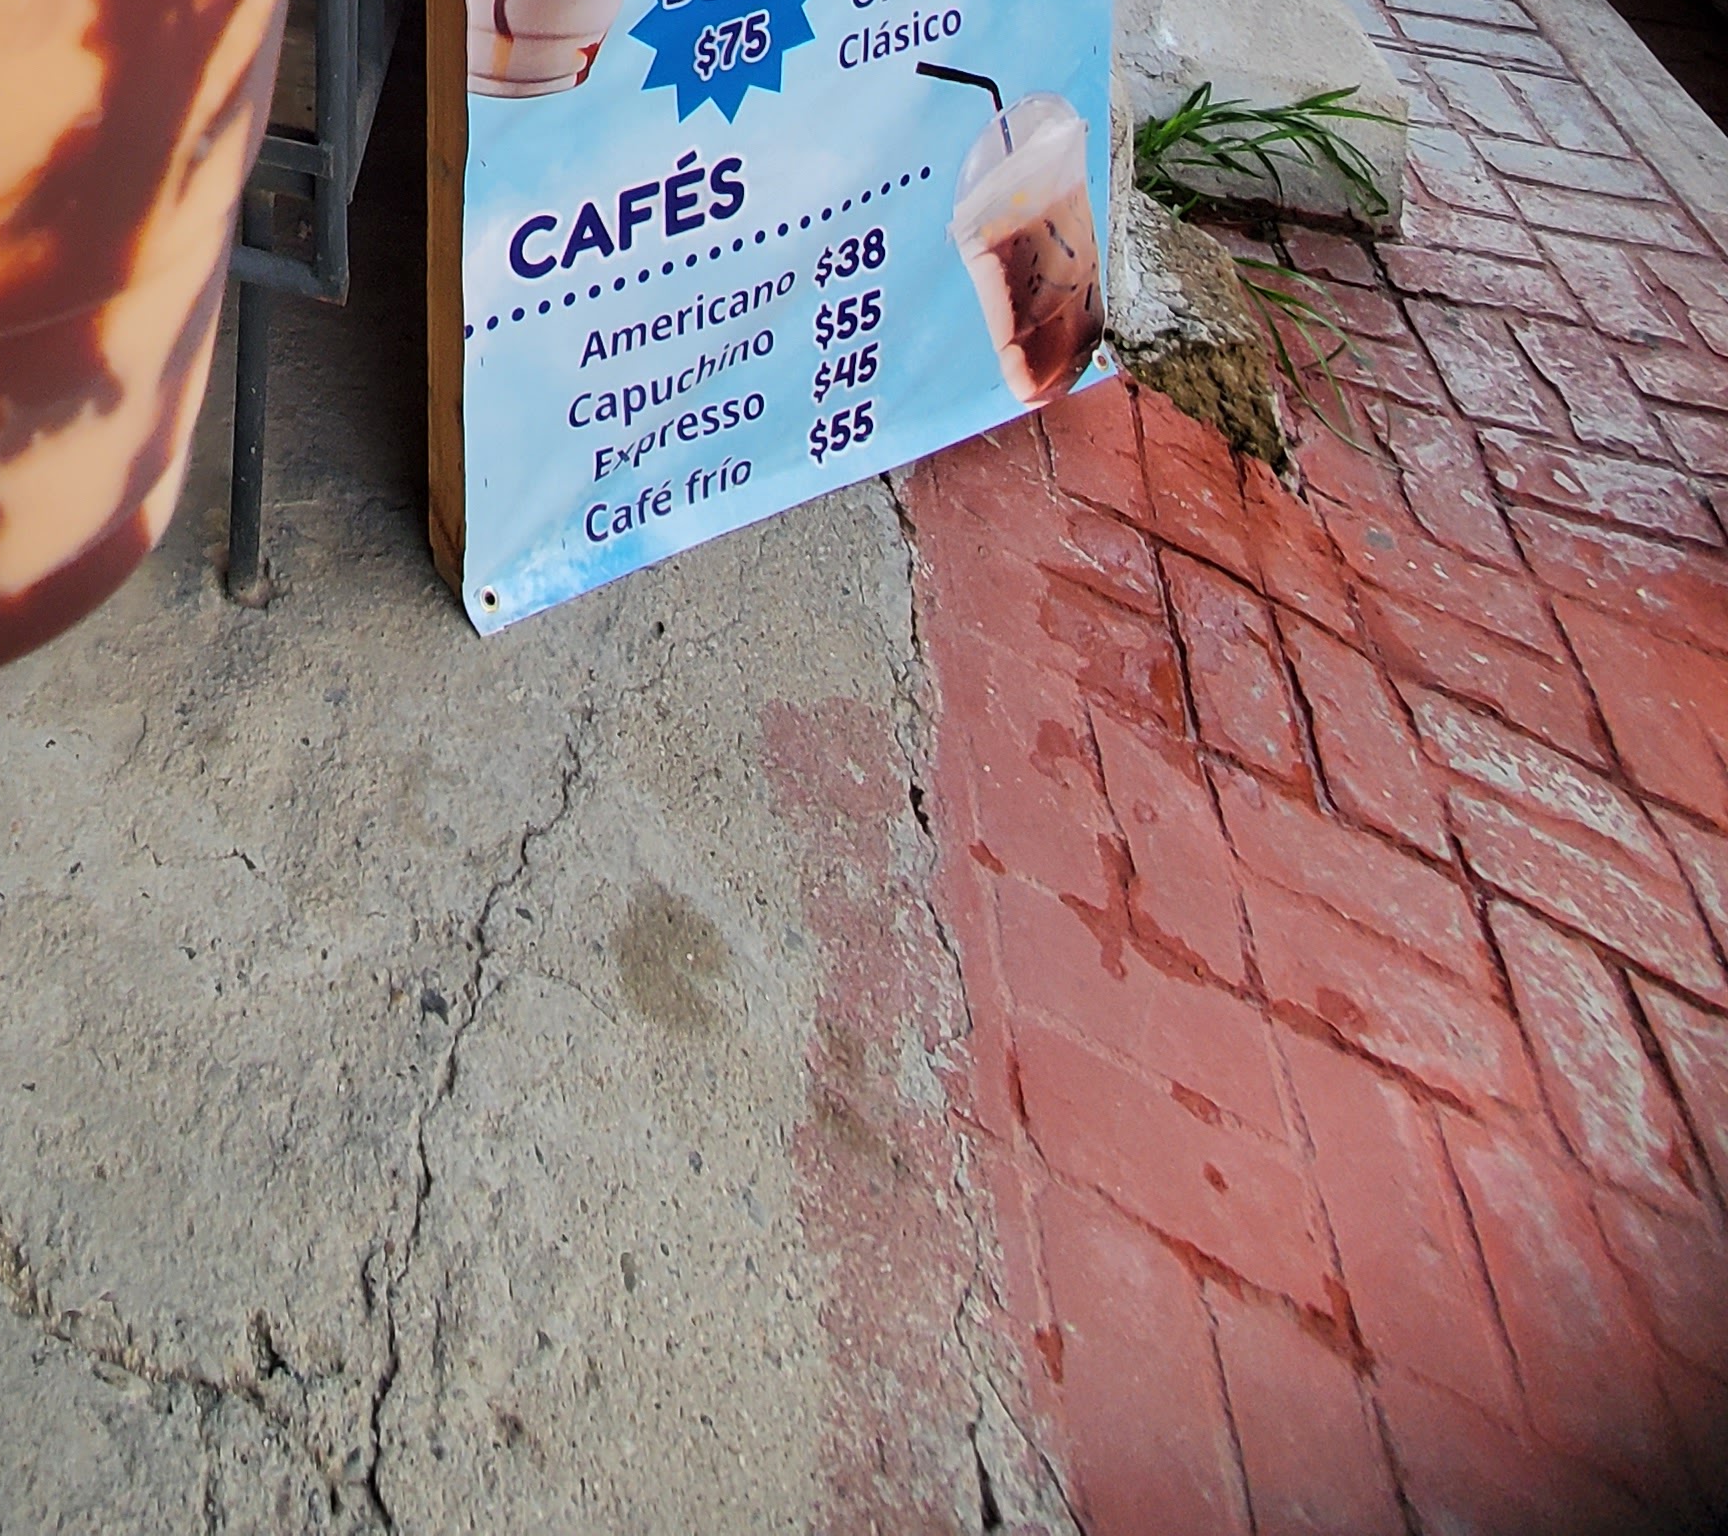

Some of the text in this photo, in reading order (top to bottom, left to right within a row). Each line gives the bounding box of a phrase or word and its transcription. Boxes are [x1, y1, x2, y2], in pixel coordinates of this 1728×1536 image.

[695, 14, 769, 78] $75
[839, 8, 962, 70] Clásico
[509, 150, 745, 279] CAFÉS
[569, 291, 881, 428] Capuchino $55
[580, 228, 886, 368] Americano $38
[586, 401, 874, 543] Café frío $55
[594, 344, 878, 481] Expresso $45
